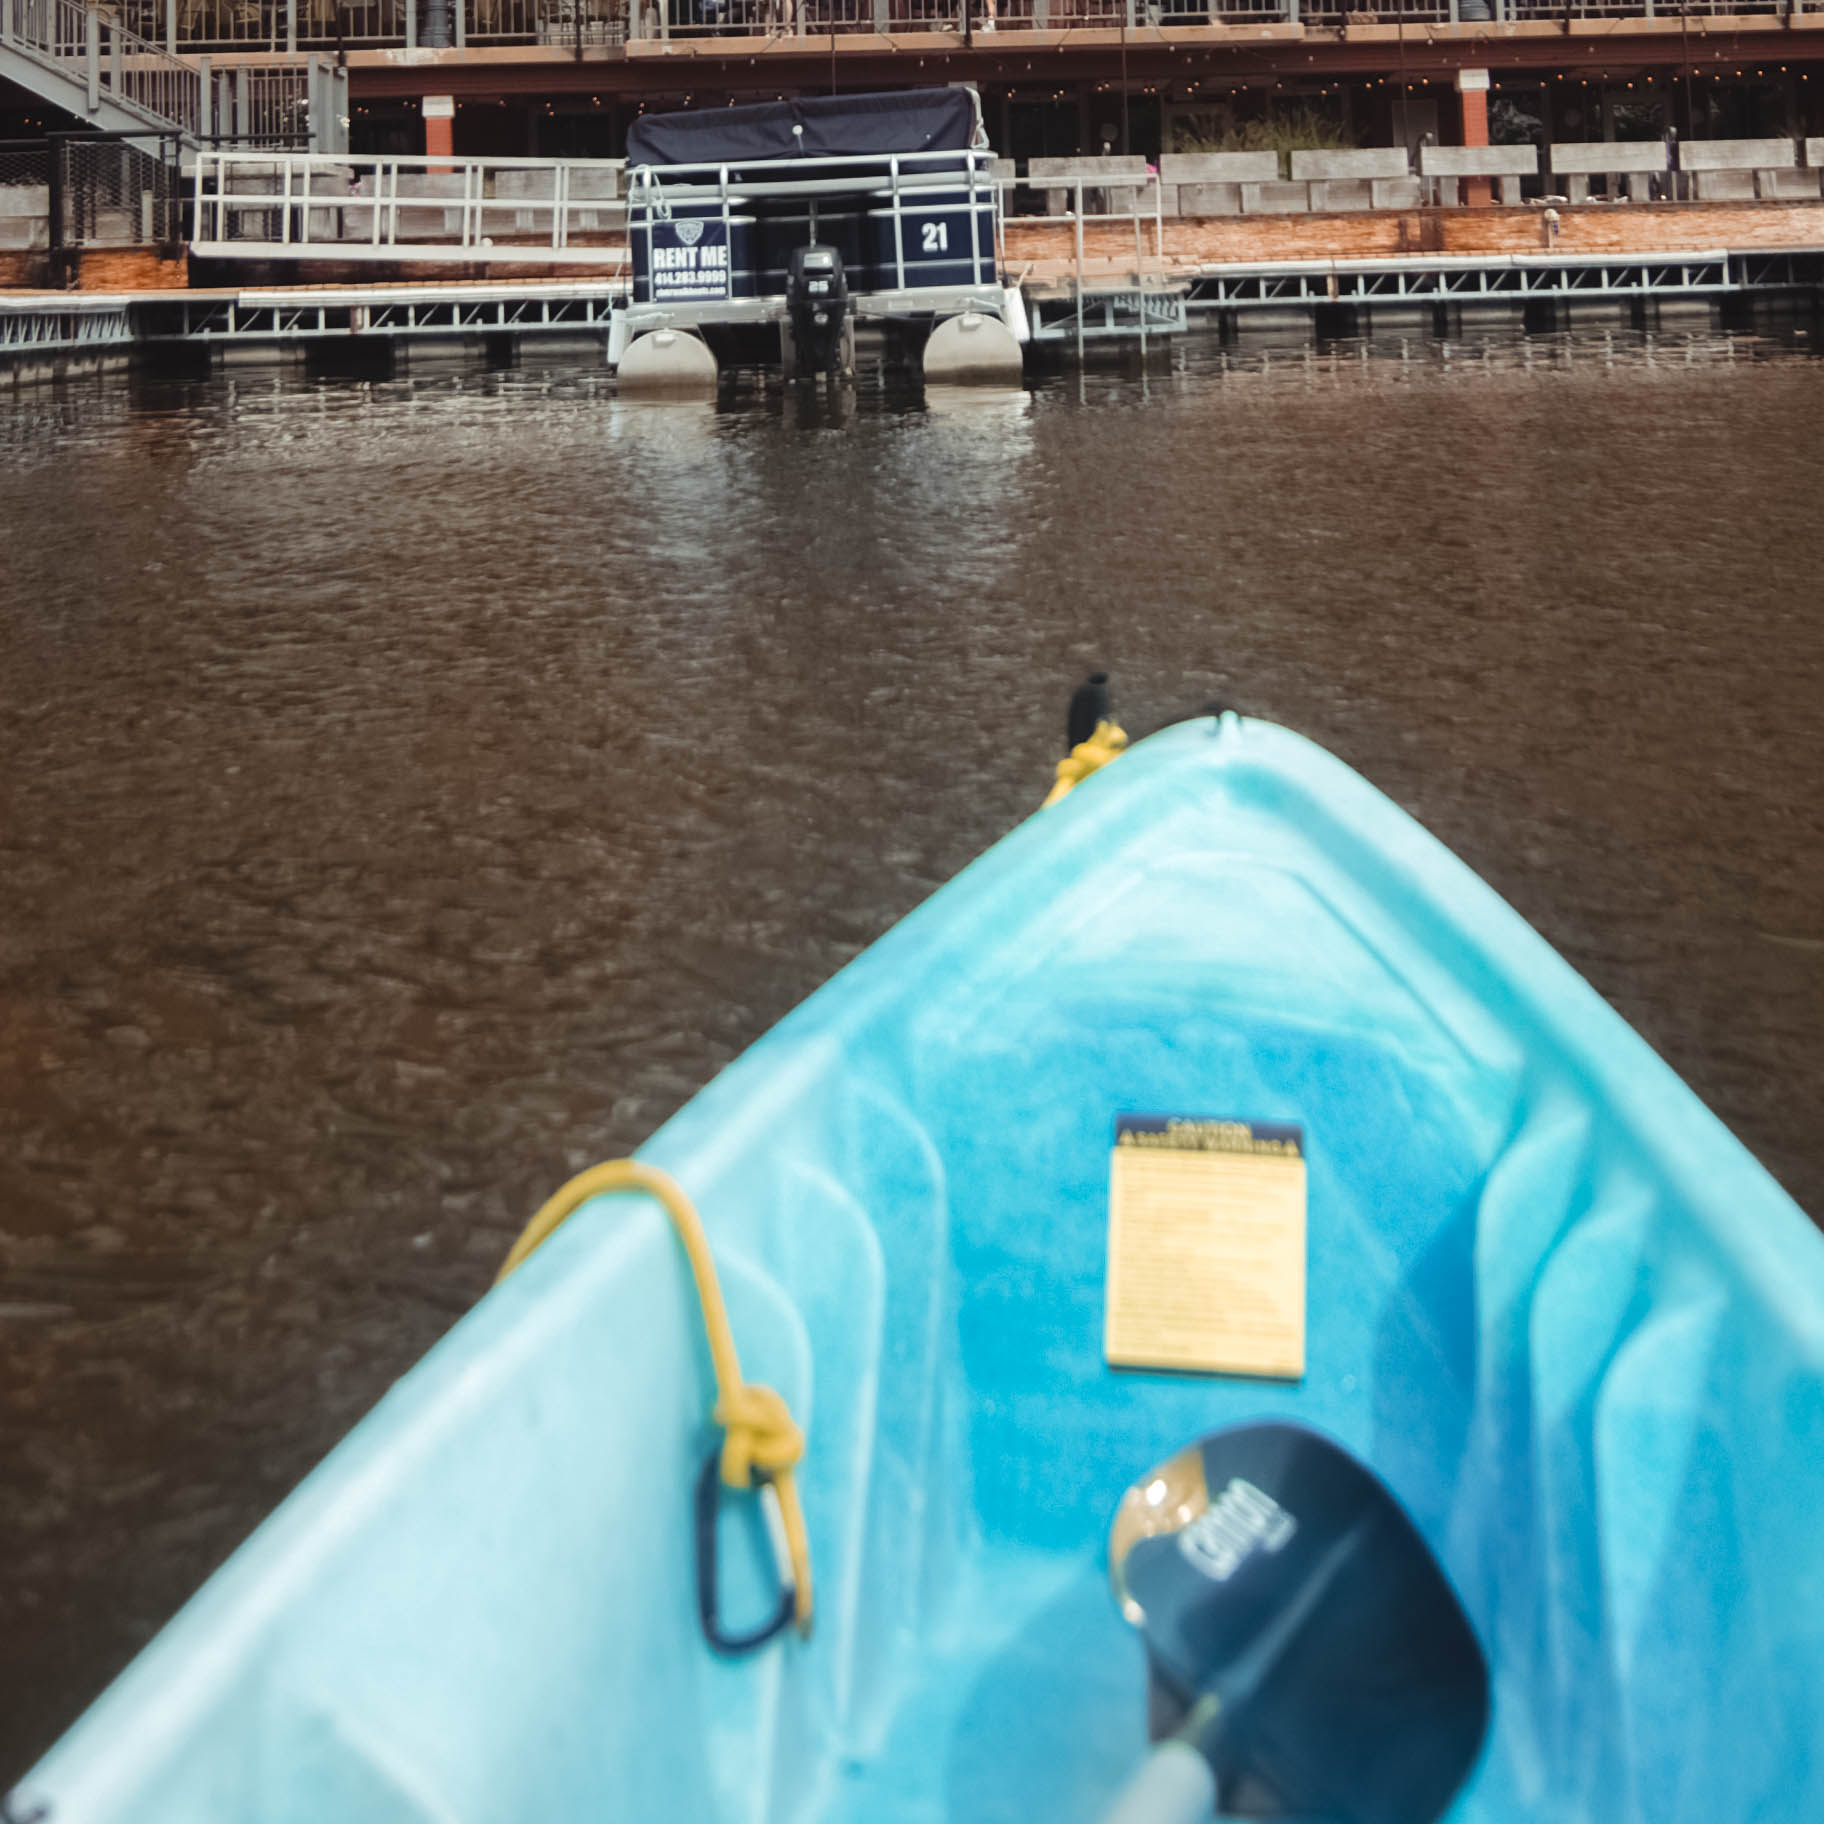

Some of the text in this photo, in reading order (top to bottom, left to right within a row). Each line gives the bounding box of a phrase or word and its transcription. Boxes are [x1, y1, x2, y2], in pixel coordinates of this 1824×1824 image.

[921, 222, 948, 253] 21
[653, 245, 727, 270] RENT ME
[808, 280, 829, 293] 25
